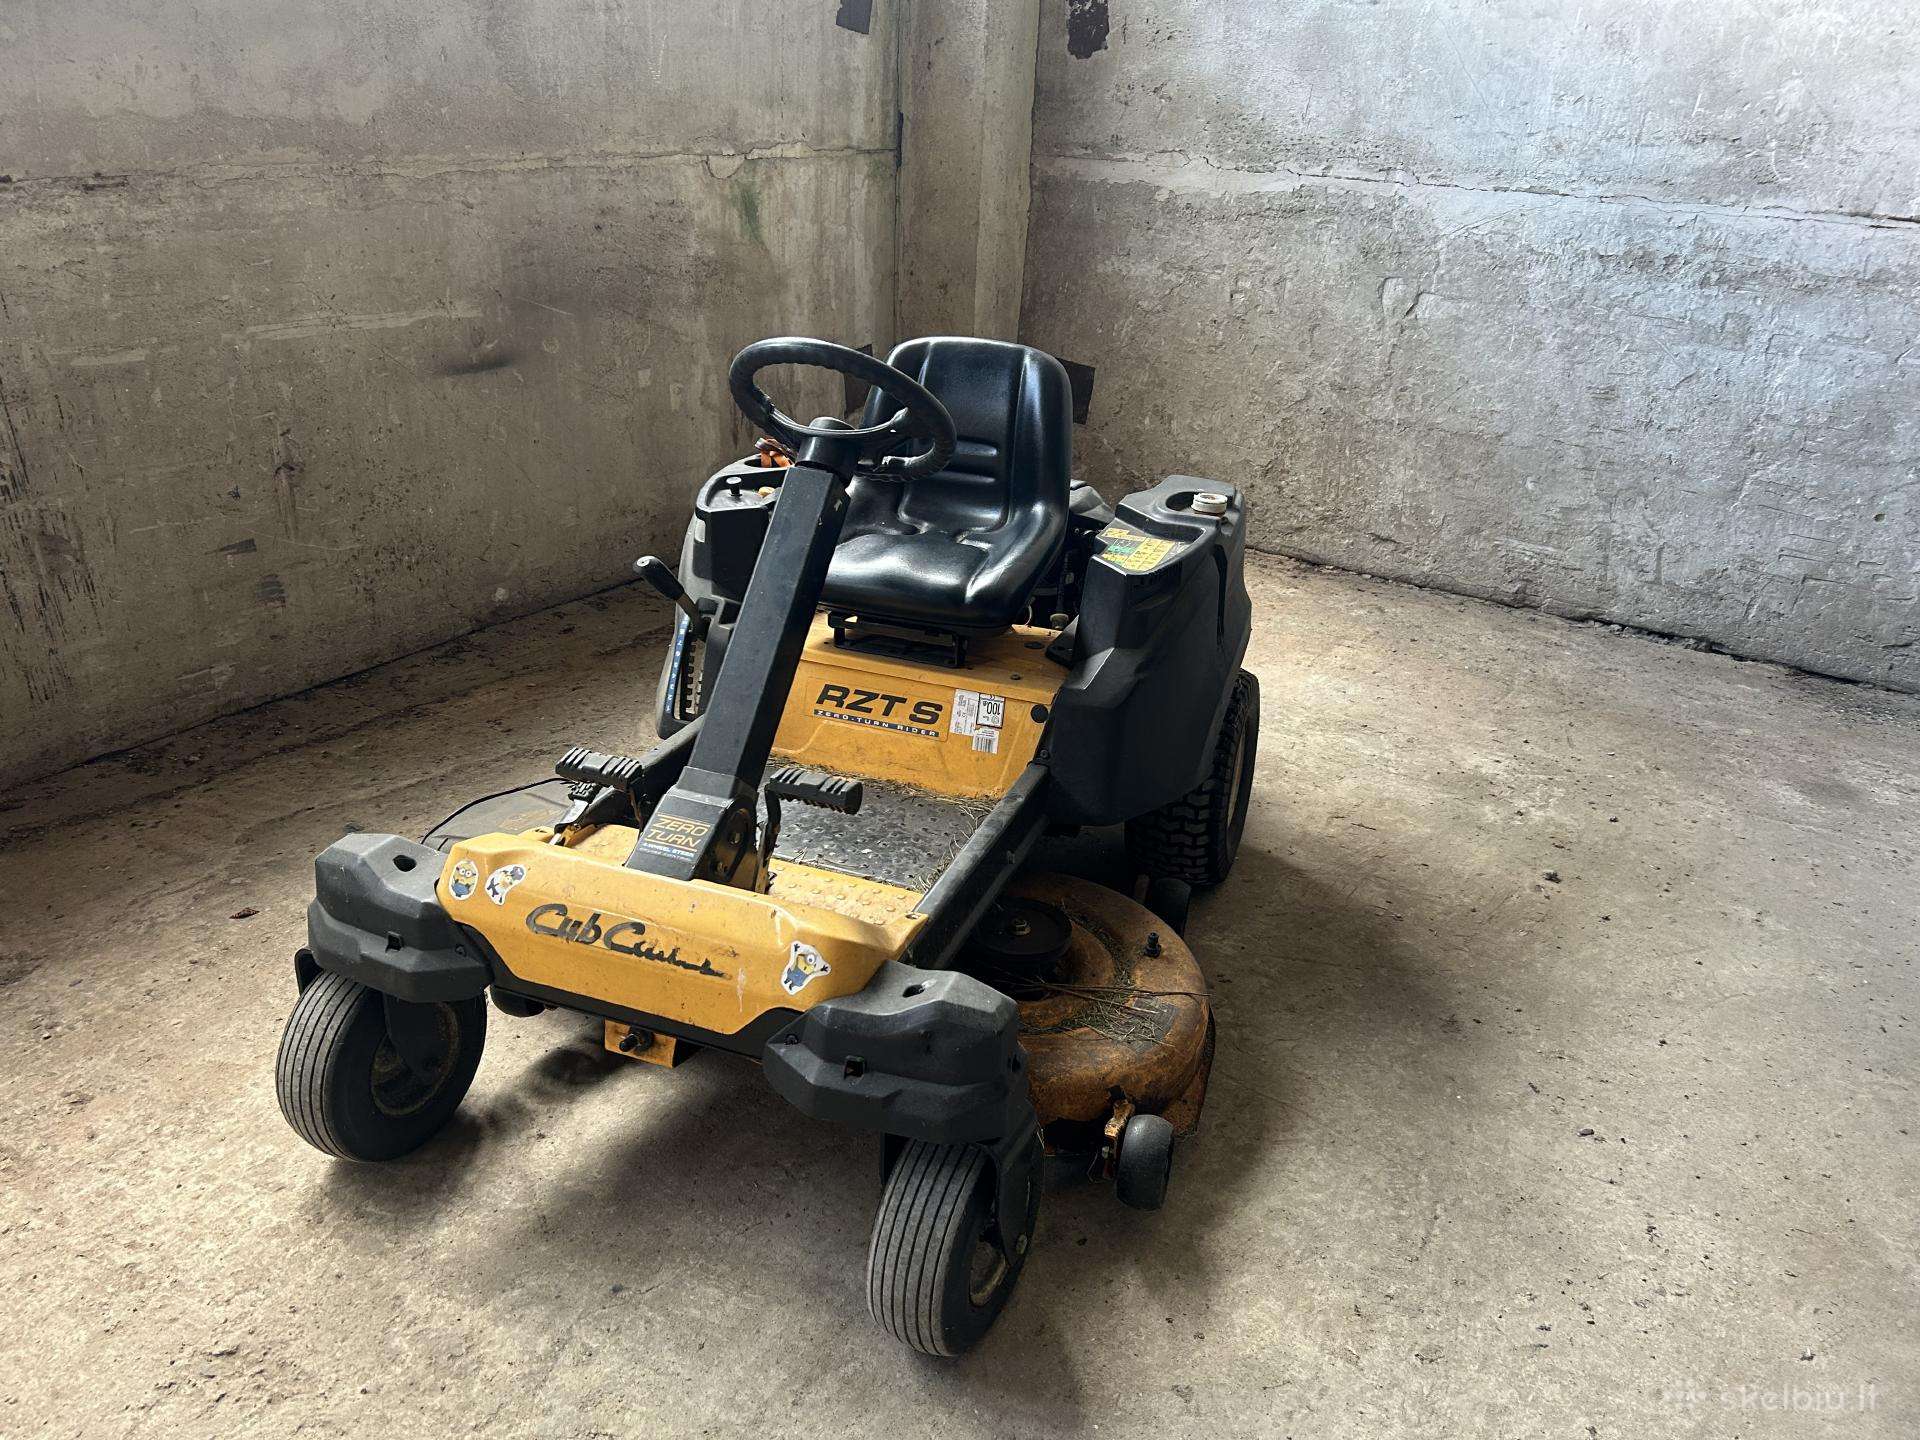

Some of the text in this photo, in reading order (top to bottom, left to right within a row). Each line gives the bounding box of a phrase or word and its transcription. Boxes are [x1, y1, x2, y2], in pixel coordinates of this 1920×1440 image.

[816, 683, 908, 717] RZT
[908, 701, 943, 725] S
[817, 710, 938, 737] ZERO-TURN RIDER
[647, 828, 702, 848] TURN
[652, 817, 710, 837] ZERO
[525, 903, 602, 944] Cub
